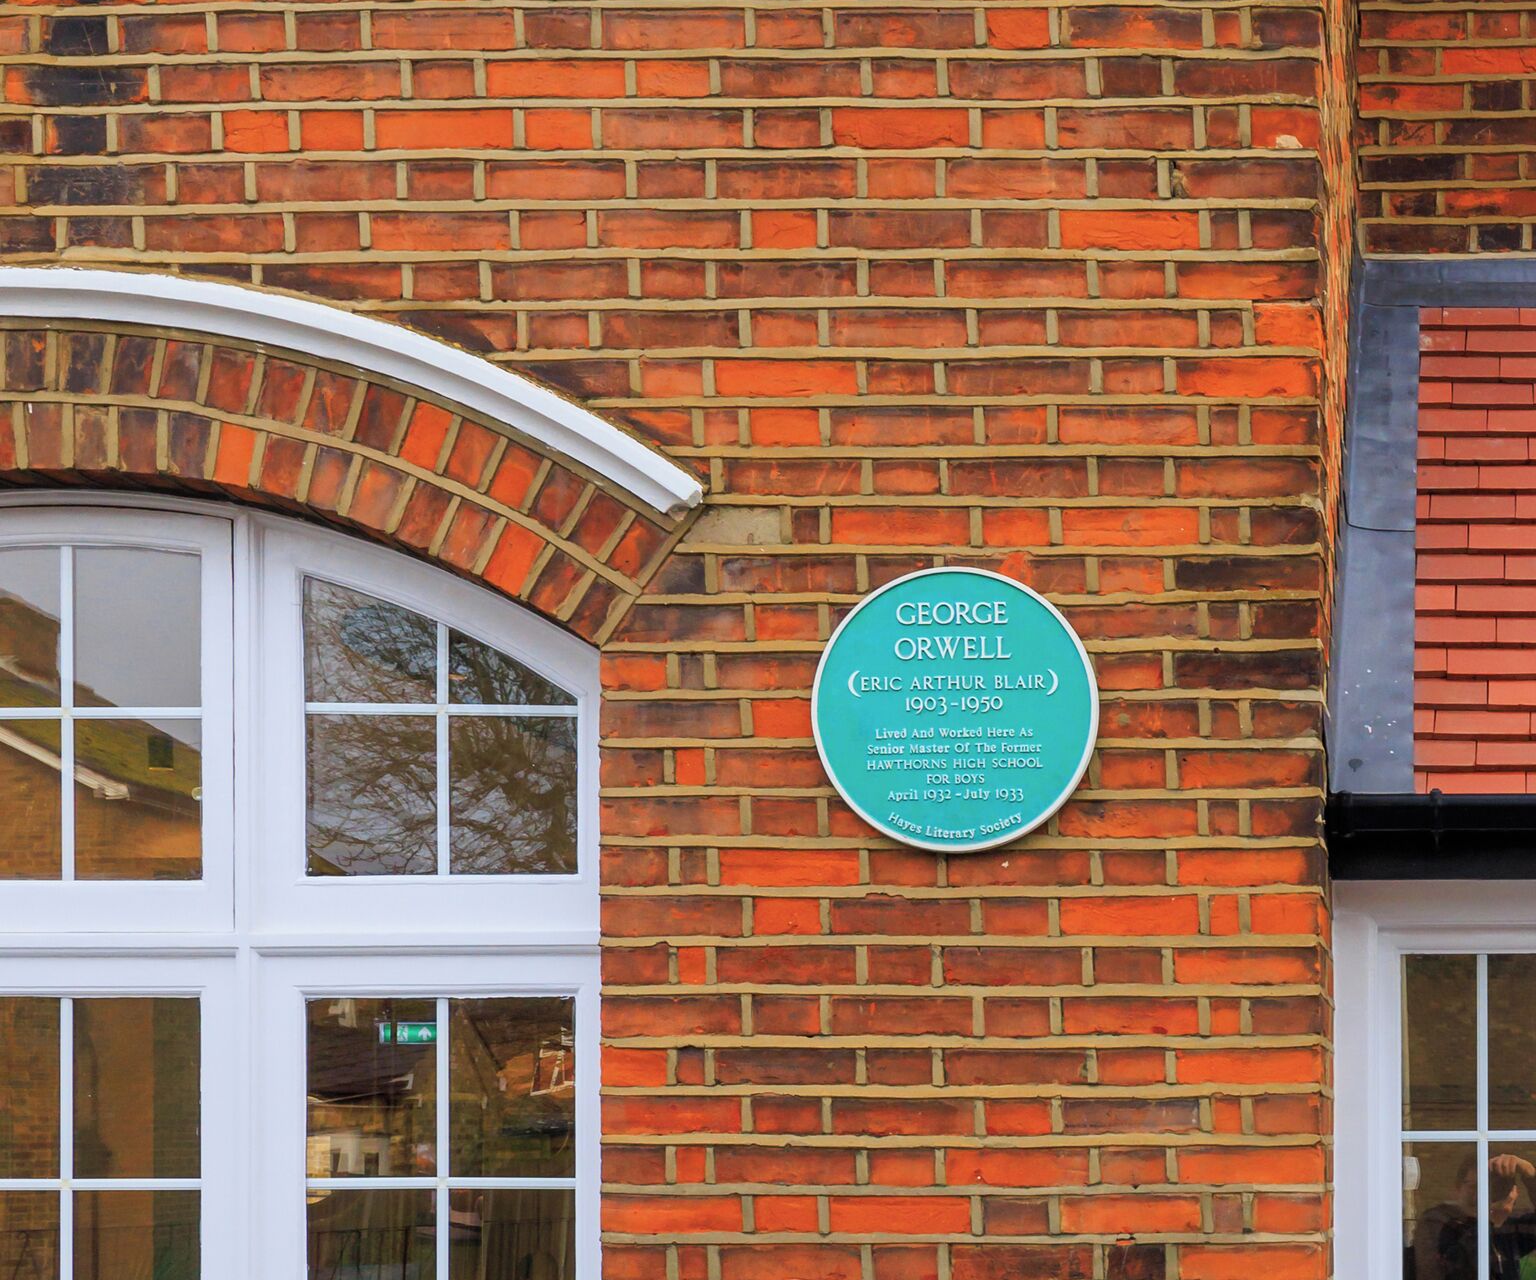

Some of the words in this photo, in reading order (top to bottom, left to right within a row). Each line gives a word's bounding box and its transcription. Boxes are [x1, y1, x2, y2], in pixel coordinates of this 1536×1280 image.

[896, 602, 1008, 625] GEORGE
[894, 636, 1011, 660] ORWELL
[848, 670, 902, 697] (ERIC
[910, 675, 986, 690] ARTHUR
[994, 668, 1058, 695] BLAIR)
[875, 728, 907, 739] Lived
[912, 727, 934, 738] And
[939, 727, 982, 738] Worked
[987, 727, 1015, 737] Here
[1020, 727, 1033, 737] As
[867, 743, 904, 754] Senior
[909, 743, 950, 753] Master
[954, 742, 970, 753] Of
[975, 742, 997, 752] The
[1001, 741, 1042, 752] Former
[867, 759, 947, 770] HAWTHORNS
[953, 758, 986, 769] HIGH
[992, 757, 1043, 768] SCHOOL
[926, 774, 950, 784] FOR
[955, 773, 985, 784] BOYS
[888, 789, 918, 801] April
[924, 789, 951, 802] 1932
[996, 788, 1024, 802] 1933
[888, 812, 922, 834] Hayes
[925, 825, 975, 838] Literary
[980, 812, 1022, 835] Society
